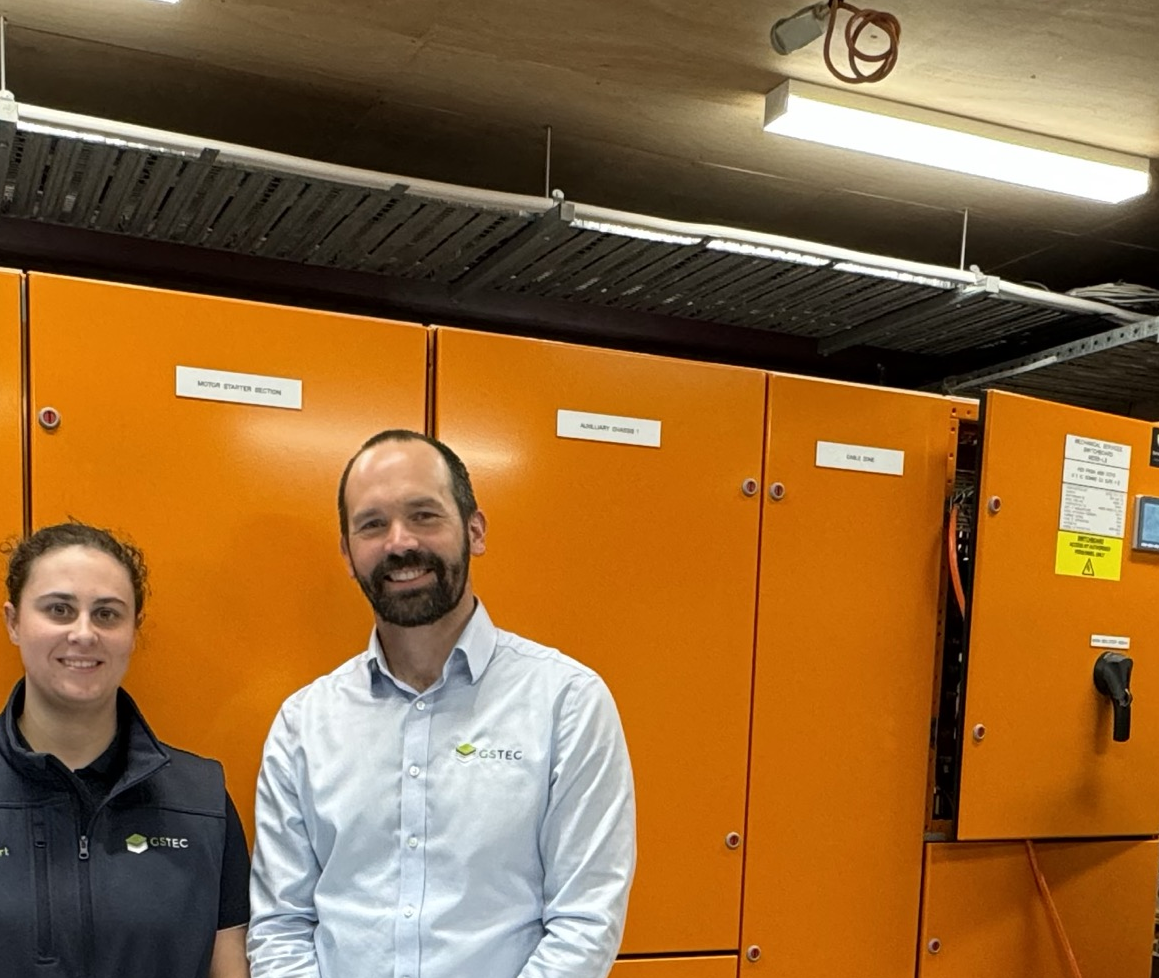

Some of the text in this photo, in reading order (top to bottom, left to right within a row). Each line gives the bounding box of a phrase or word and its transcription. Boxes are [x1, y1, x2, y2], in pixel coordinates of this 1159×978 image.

[197, 380, 282, 396] MOTOR STARTER SECTION
[478, 749, 523, 760] GSTEC
[150, 837, 189, 848] GSTEC
